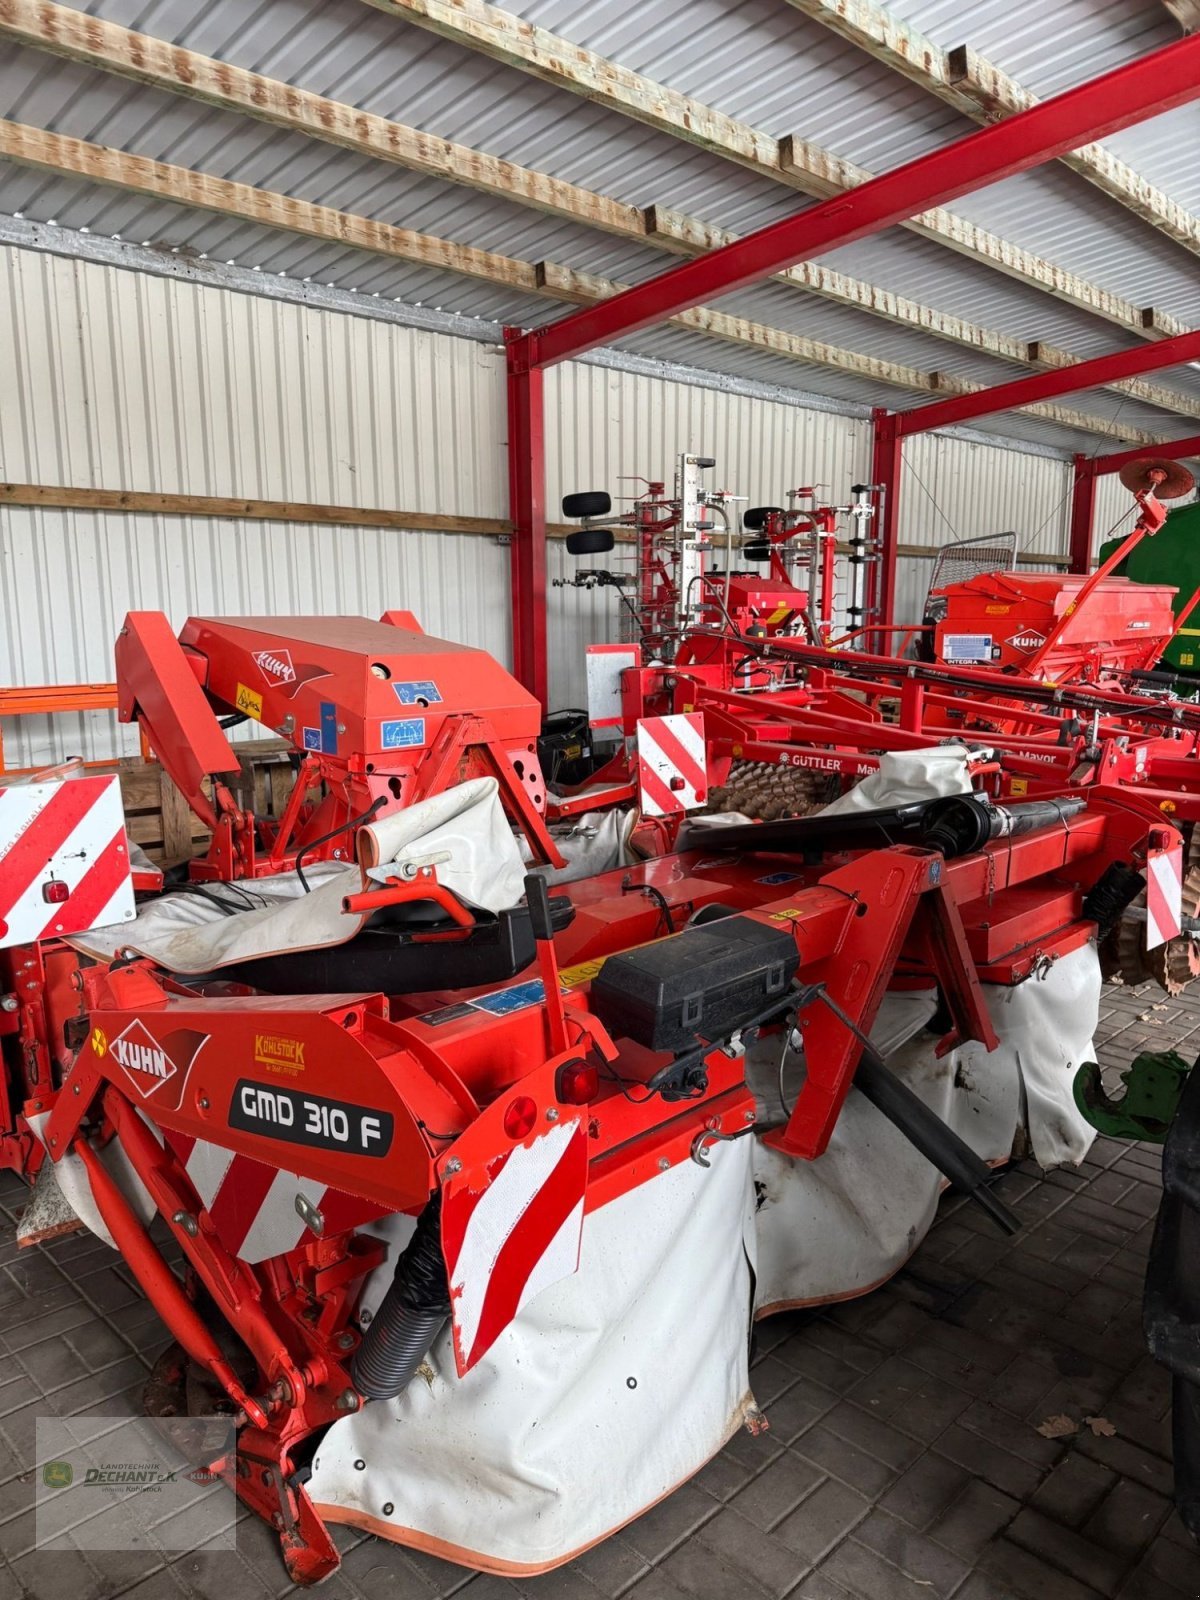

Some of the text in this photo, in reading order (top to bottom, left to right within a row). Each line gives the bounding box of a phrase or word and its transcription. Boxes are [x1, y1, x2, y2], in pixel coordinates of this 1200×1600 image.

[256, 652, 293, 682] KUHN
[117, 1038, 168, 1080] KUHN
[254, 1034, 305, 1065] KOHLSTOCK
[241, 1086, 382, 1149] GMD 310 F
